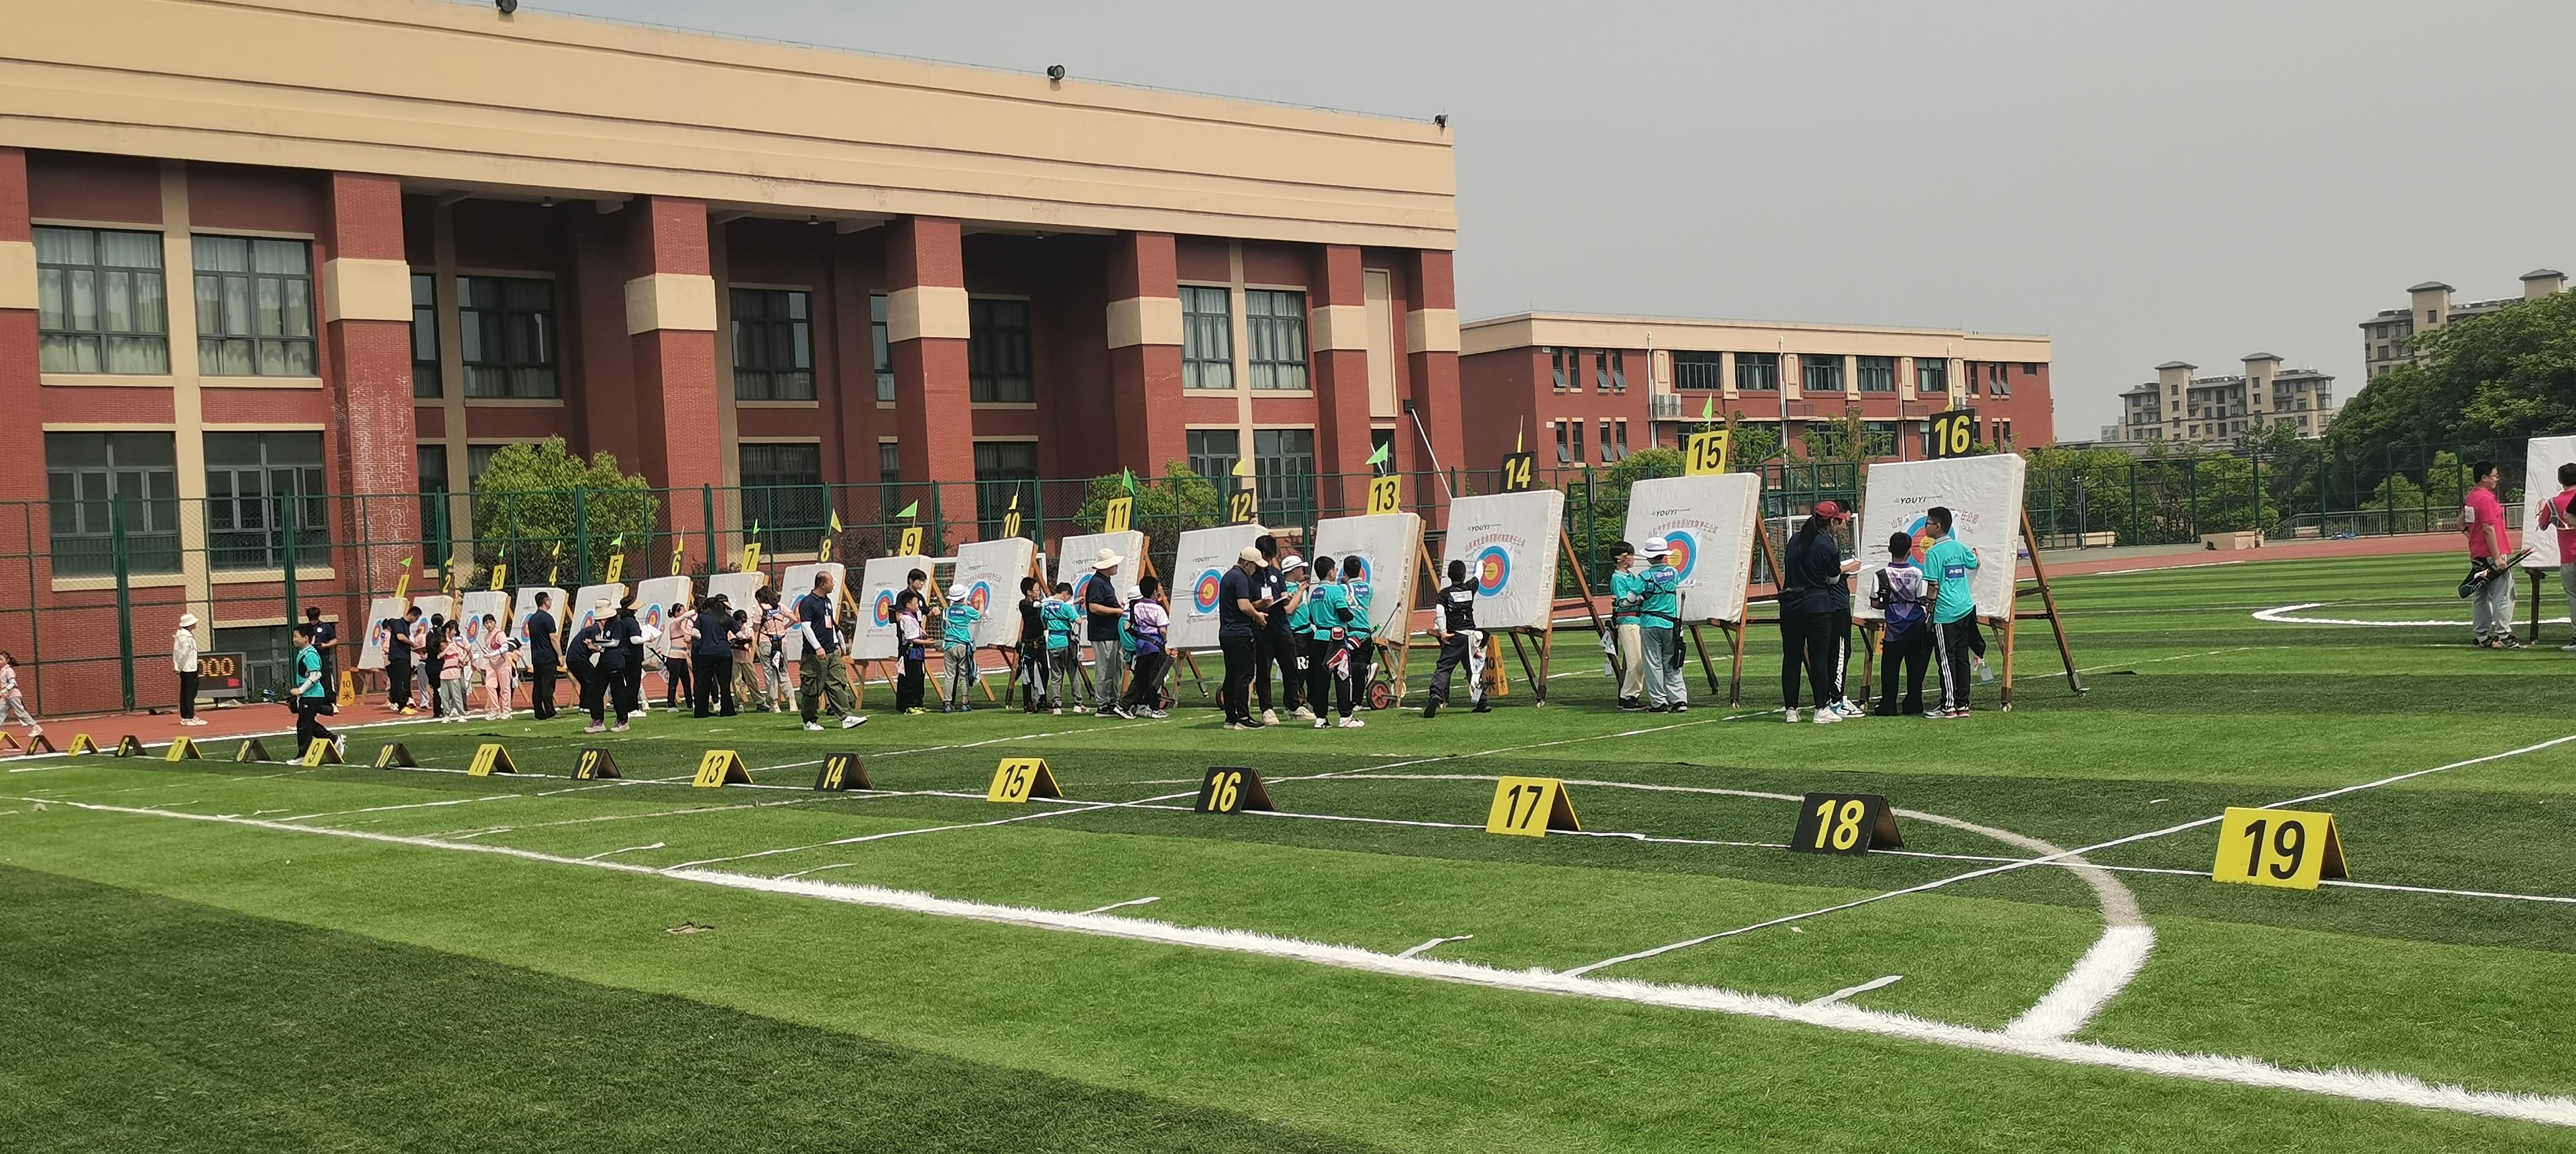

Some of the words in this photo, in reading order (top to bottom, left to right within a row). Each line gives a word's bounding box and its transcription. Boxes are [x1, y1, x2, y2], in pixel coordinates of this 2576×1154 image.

[1934, 415, 1971, 456] 16
[1694, 436, 1722, 471] 15
[1504, 457, 1531, 490] 14
[1231, 493, 1251, 522] 12
[1374, 481, 1396, 511] 13
[1003, 512, 1021, 538] 10
[1110, 502, 1128, 529] 11
[821, 538, 832, 562] 8
[905, 533, 916, 556] 9
[610, 559, 619, 578] 5
[671, 554, 681, 575] 6
[746, 548, 755, 570] 7
[399, 579, 405, 594] 1
[443, 575, 452, 593] 2
[494, 569, 501, 587] 3
[549, 565, 558, 586] 4
[1485, 657, 1495, 670] 10
[342, 690, 353, 700] 米
[1484, 675, 1495, 693] 米
[118, 737, 130, 755] 6
[172, 739, 182, 759] 7
[237, 740, 250, 762] 8
[308, 741, 320, 763] 9
[375, 744, 394, 768] 10
[475, 748, 493, 773] 11
[577, 751, 597, 779] 12
[702, 755, 724, 784] 13
[823, 756, 847, 789] 14
[1000, 764, 1029, 798] 15
[1208, 772, 1242, 812] 16
[1505, 784, 1543, 829] 17
[1815, 800, 1865, 850] 18
[2243, 819, 2305, 879] 19
